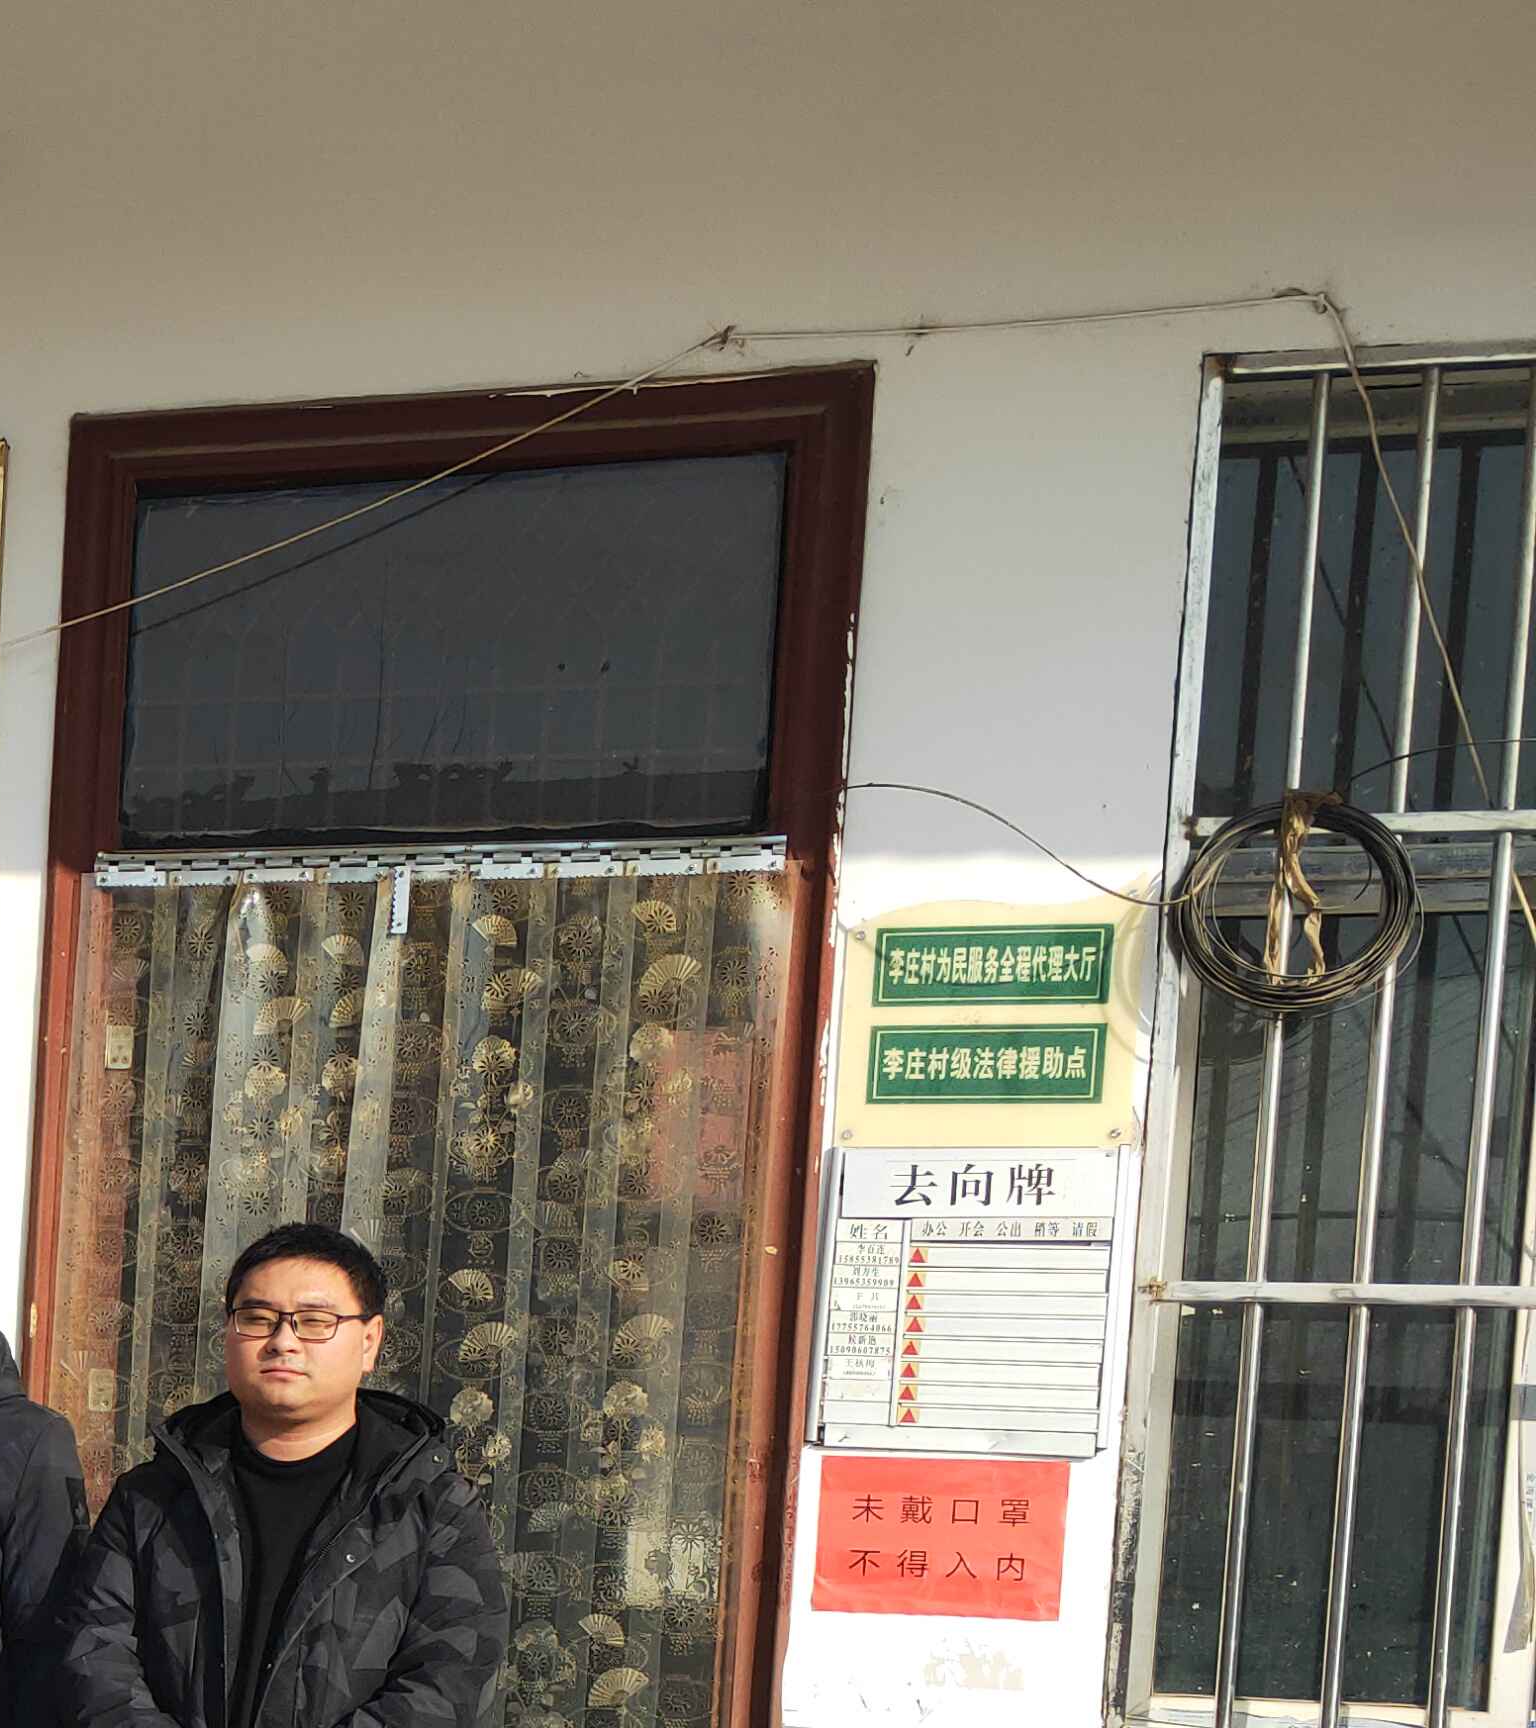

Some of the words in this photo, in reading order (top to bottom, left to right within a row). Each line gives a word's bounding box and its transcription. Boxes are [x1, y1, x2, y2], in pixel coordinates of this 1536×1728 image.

[888, 944, 1097, 986] 李庄村为民服务全程代理大厅
[882, 1045, 1088, 1081] 李庄村级法律援助点
[889, 1162, 1056, 1207] 去向牌
[849, 1223, 889, 1241] 姓名
[921, 1220, 947, 1237] 办公
[958, 1221, 986, 1238] 开会
[994, 1221, 1022, 1238] 公出
[1071, 1222, 1099, 1238] 请假
[851, 1493, 1032, 1528] 未戴口罩
[848, 1549, 1026, 1582] 不得入内
